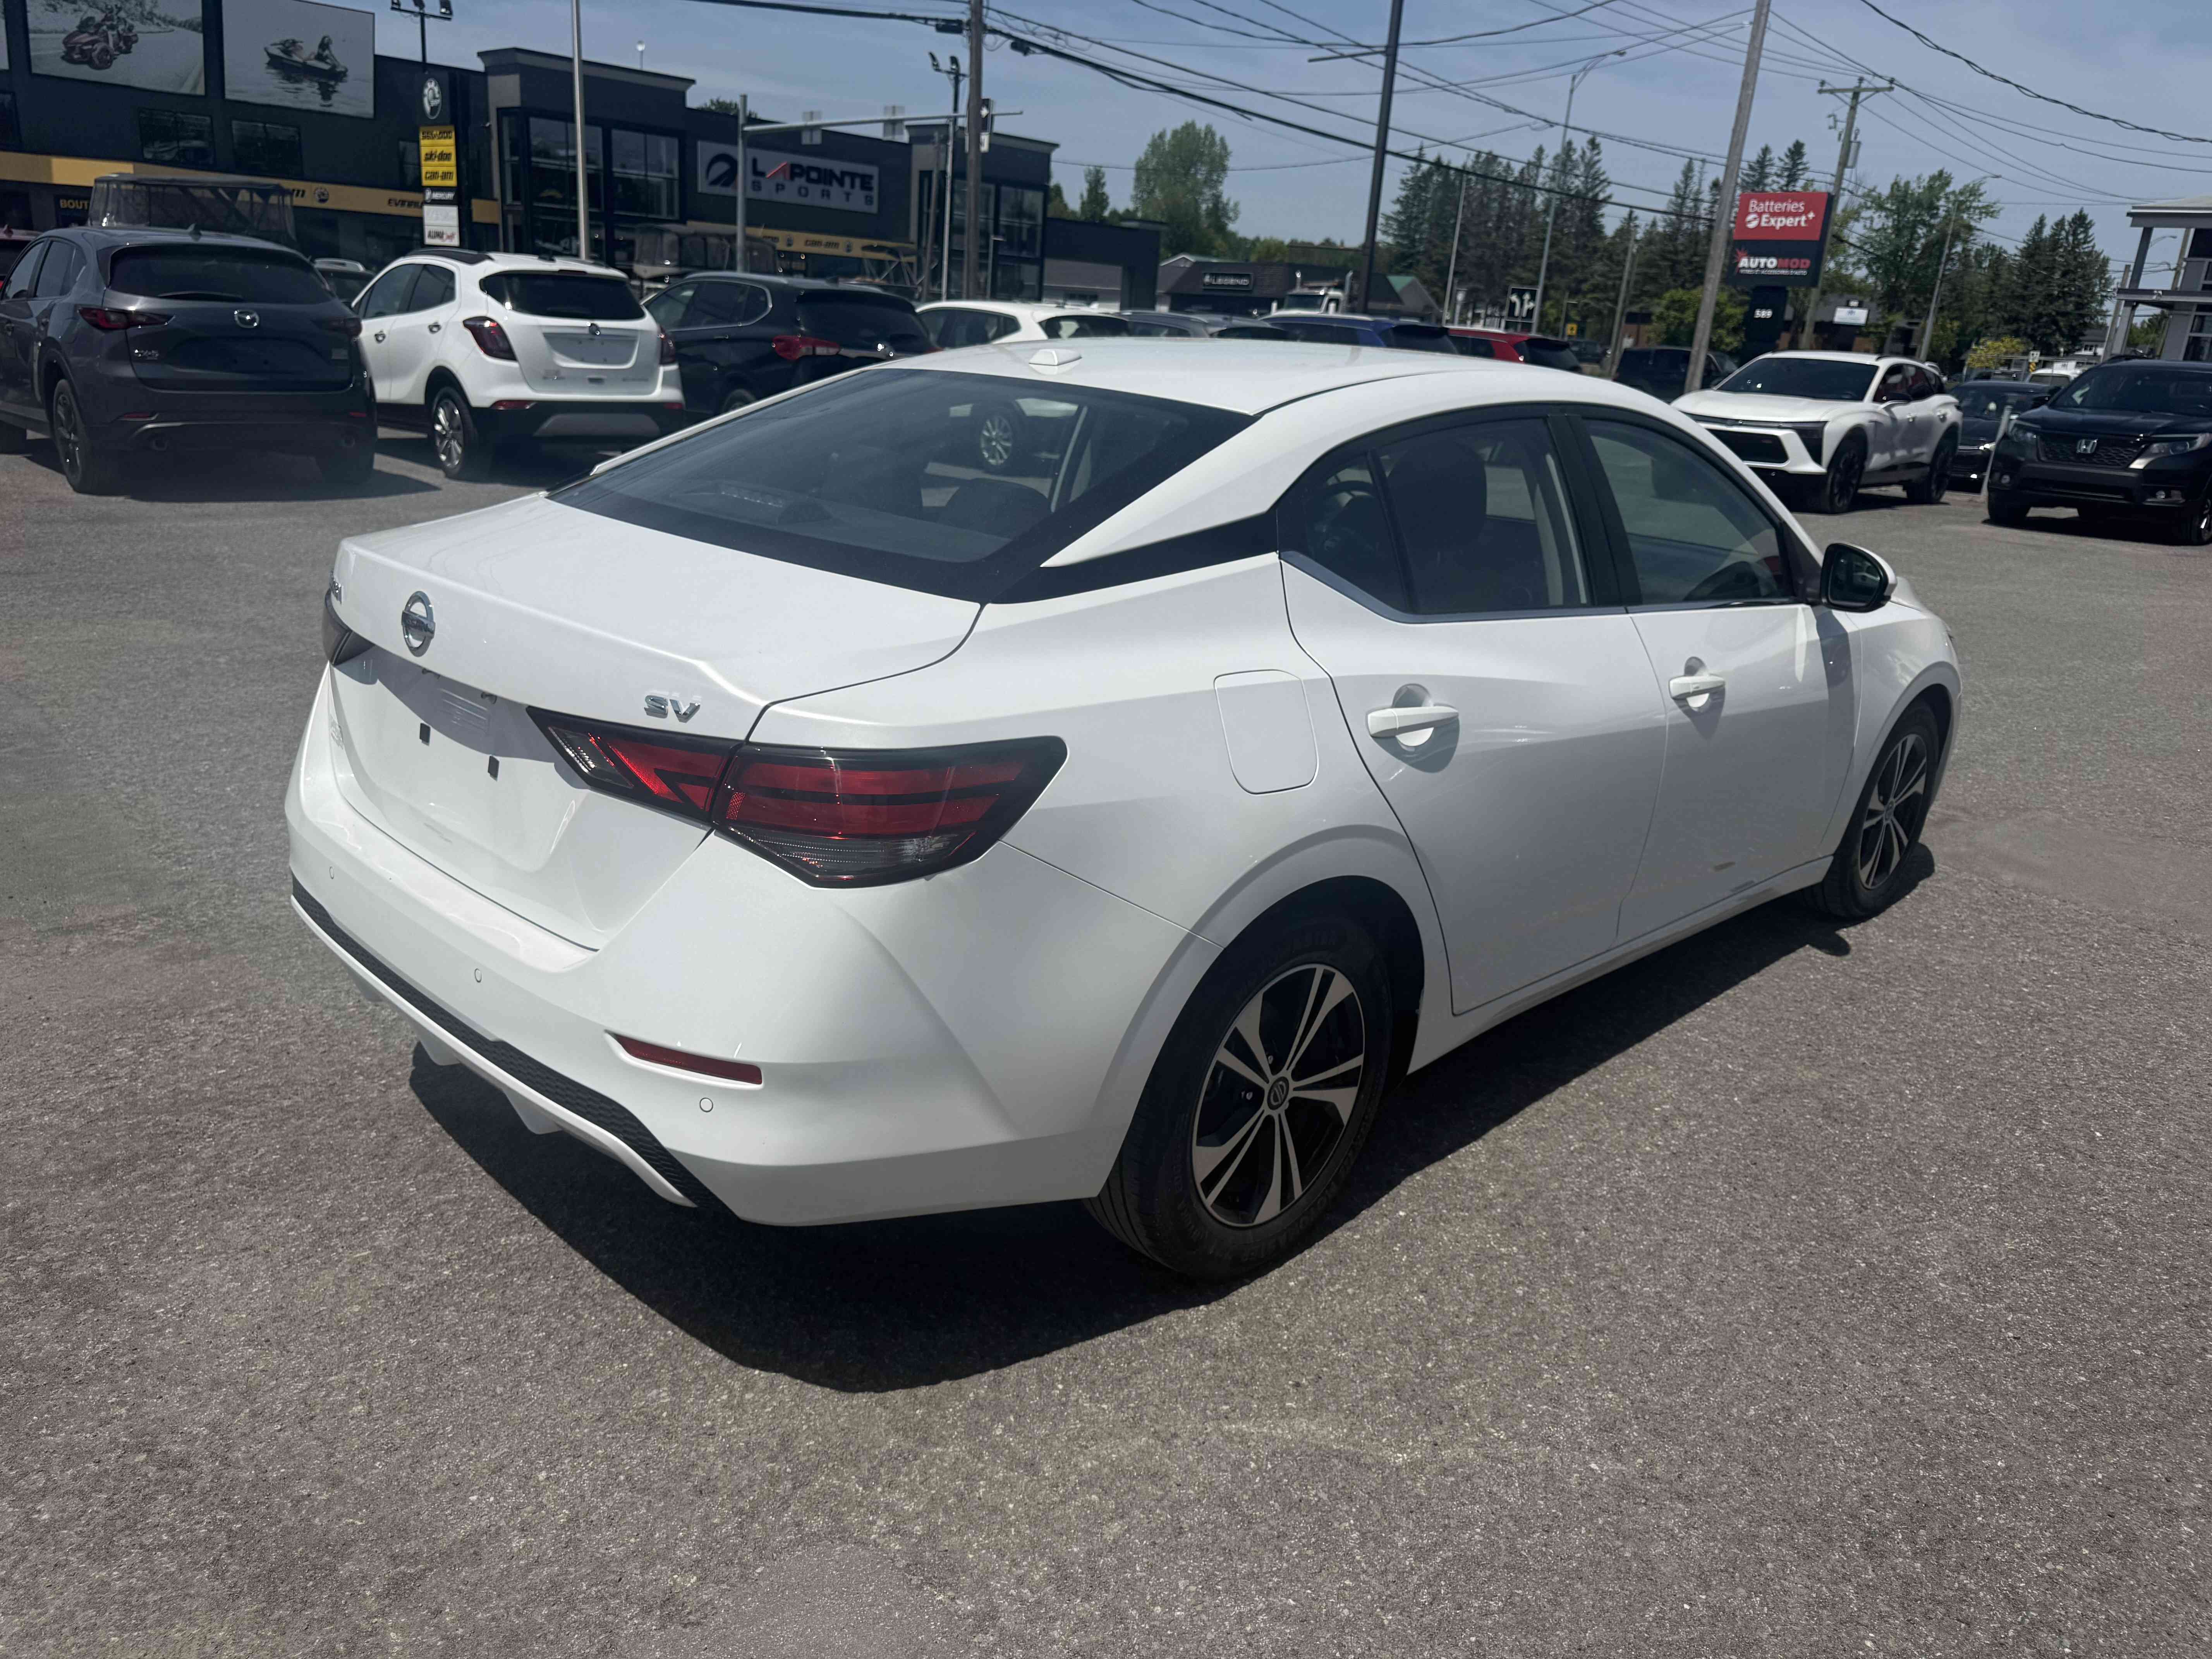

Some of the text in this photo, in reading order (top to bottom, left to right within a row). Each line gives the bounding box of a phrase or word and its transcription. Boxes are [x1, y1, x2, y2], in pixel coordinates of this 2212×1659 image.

[752, 156, 874, 191] LAPOINTE
[751, 180, 874, 206] SPORTS
[60, 198, 88, 210] BOUT
[1748, 198, 1805, 213] Batteries
[1738, 256, 1811, 269] AUTOMOD
[644, 694, 701, 723] SV
